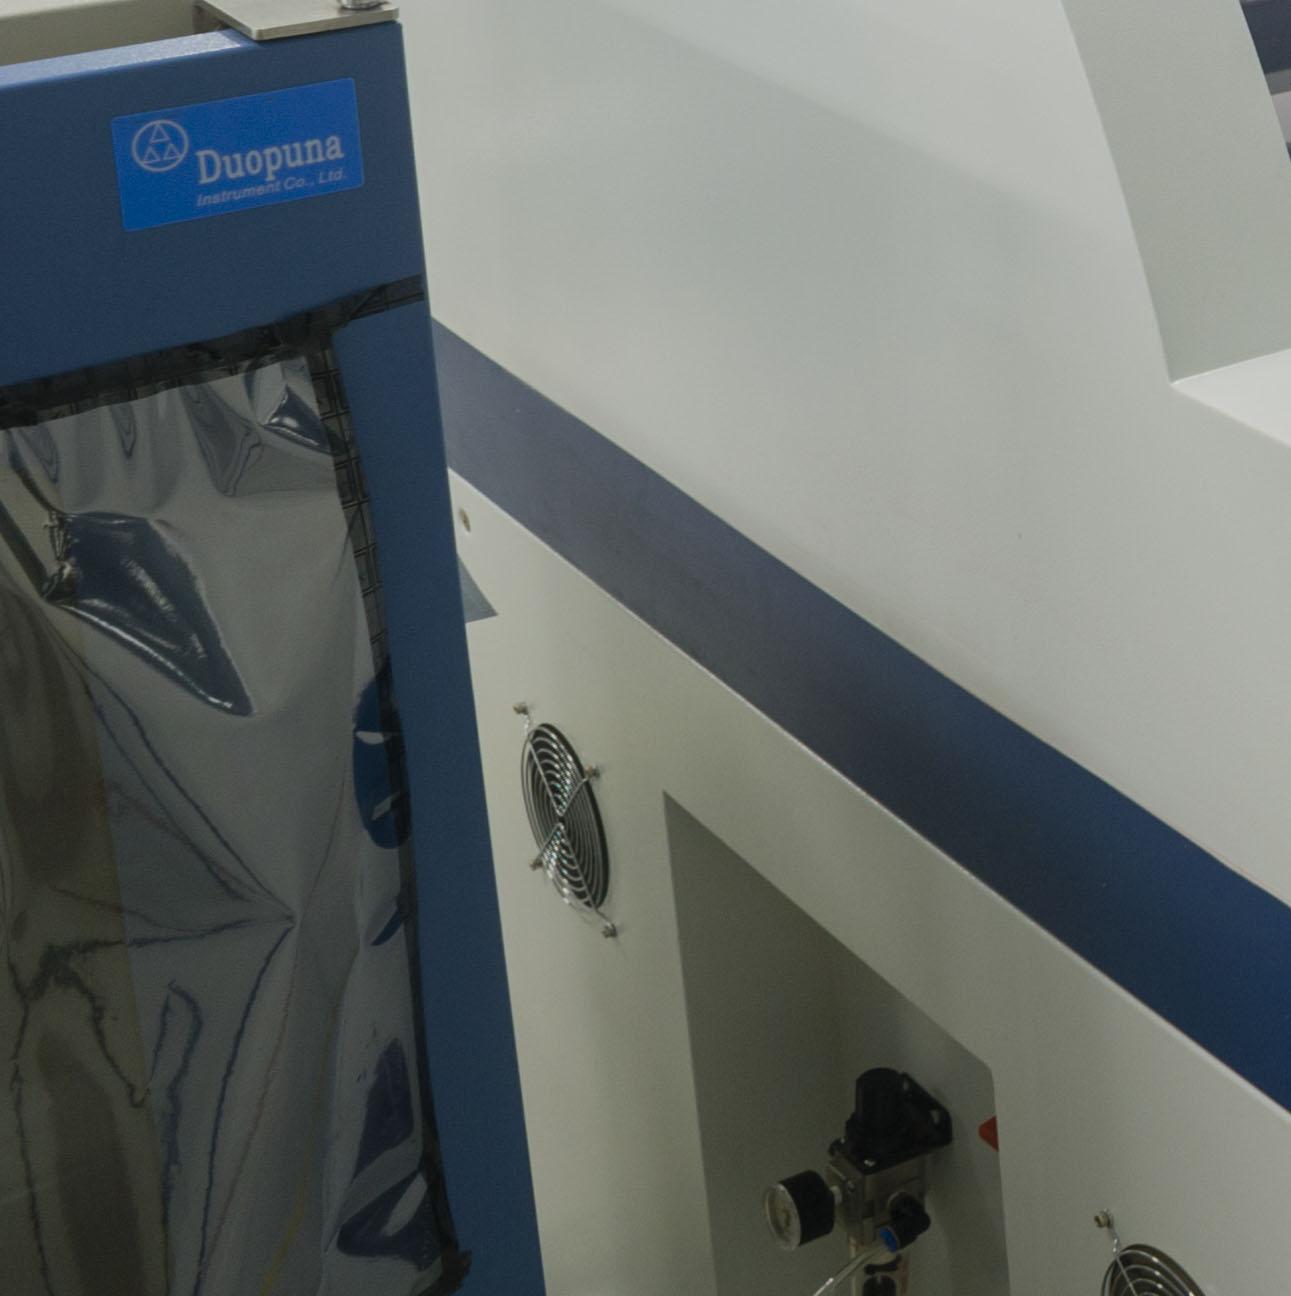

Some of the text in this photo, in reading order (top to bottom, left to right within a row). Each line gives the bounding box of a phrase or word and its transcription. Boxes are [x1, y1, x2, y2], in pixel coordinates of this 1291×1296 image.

[195, 135, 345, 185] Duopuna
[196, 180, 281, 207] Instrument
[318, 168, 347, 185] Ltd.
